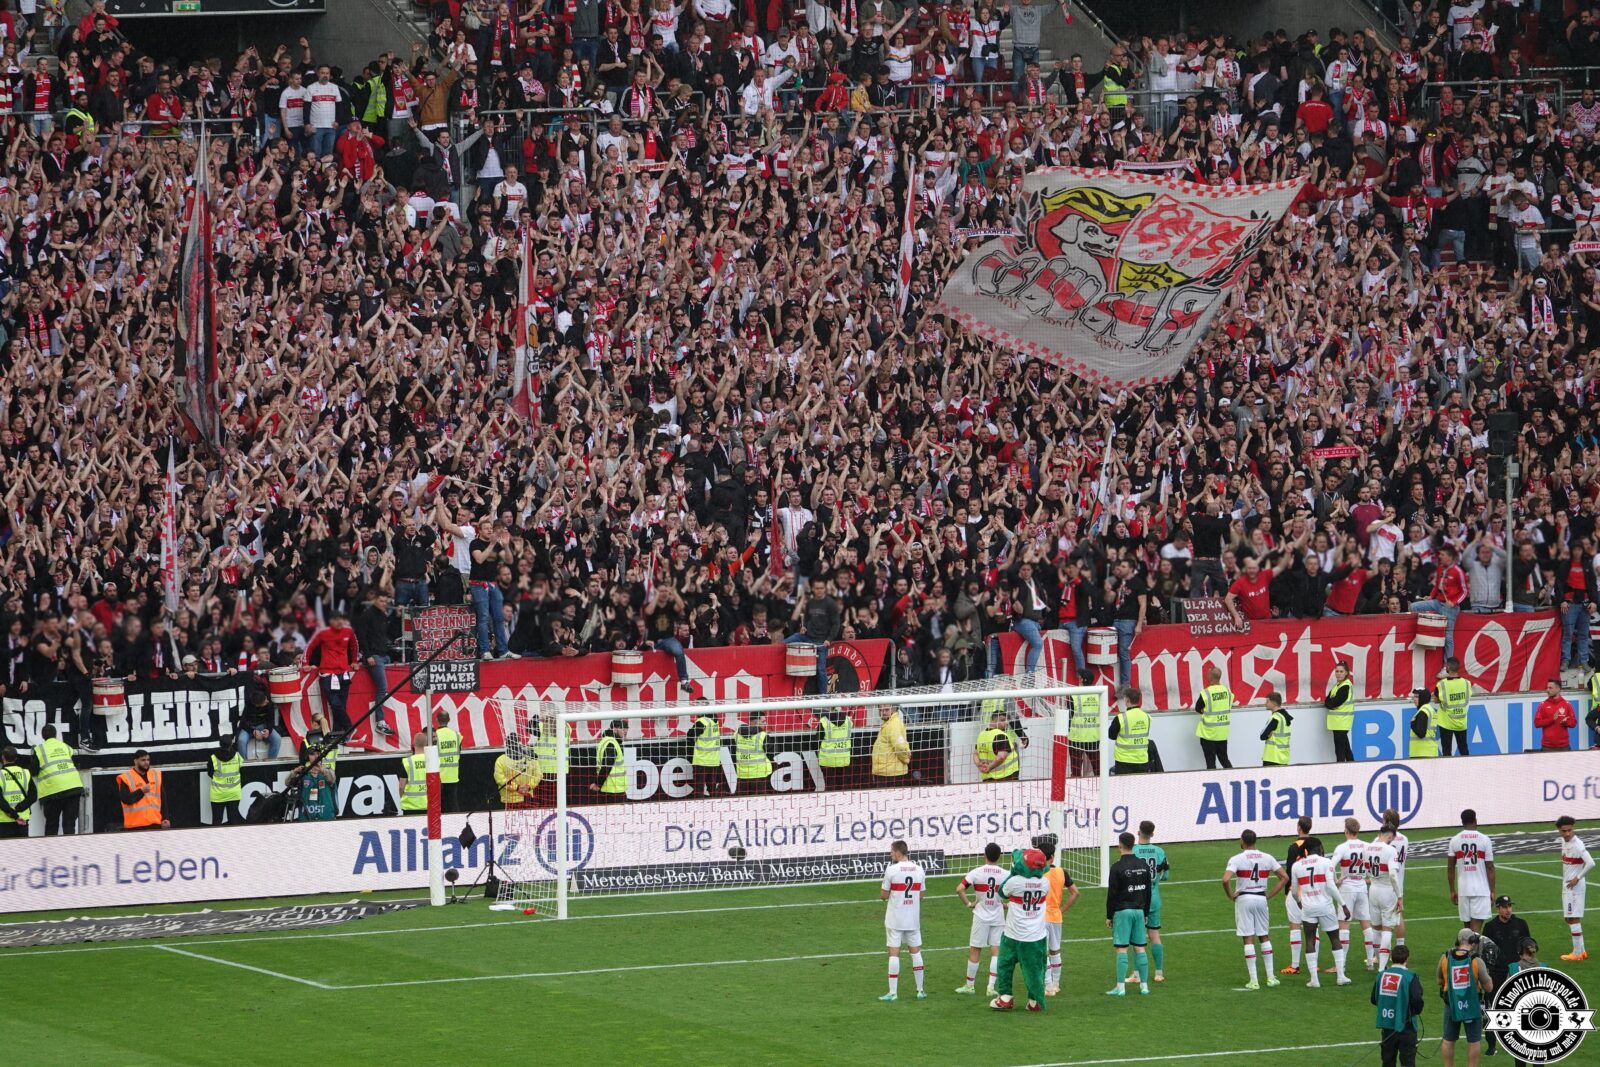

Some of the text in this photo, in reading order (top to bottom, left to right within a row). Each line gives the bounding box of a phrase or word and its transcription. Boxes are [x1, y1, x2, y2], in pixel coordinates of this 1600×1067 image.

[421, 606, 468, 617] JEDER
[1183, 599, 1222, 609] ULTRA
[413, 614, 477, 630] VERBANNTE
[1187, 613, 1209, 622] DER
[1190, 624, 1213, 635] UMS
[429, 662, 475, 672] DU BIST
[1462, 618, 1556, 695] 97
[429, 672, 476, 682] IMMER
[430, 681, 477, 691] BEI UNS!
[1211, 691, 1228, 701] SECURITY
[1449, 691, 1466, 702] SECURITY
[105, 685, 246, 743] BLEIBT!
[440, 740, 457, 750] SECURITY
[1543, 780, 1576, 802] Da
[1195, 778, 1355, 826] Allianz
[665, 821, 713, 853] Die
[723, 818, 826, 849] Allianz
[352, 827, 521, 876] Allianz
[1461, 842, 1478, 866] 23
[26, 855, 102, 890] dein
[114, 850, 229, 885] Leben.
[582, 864, 757, 890] Mercedes-Benz Bank
[1250, 862, 1259, 883] 4
[1306, 866, 1315, 888] 7
[1368, 855, 1380, 878] 16
[904, 876, 914, 899] 2
[986, 877, 996, 899] 3
[1022, 890, 1042, 911] 92
[1382, 1008, 1395, 1019] 06
[1457, 1000, 1469, 1010] 04
